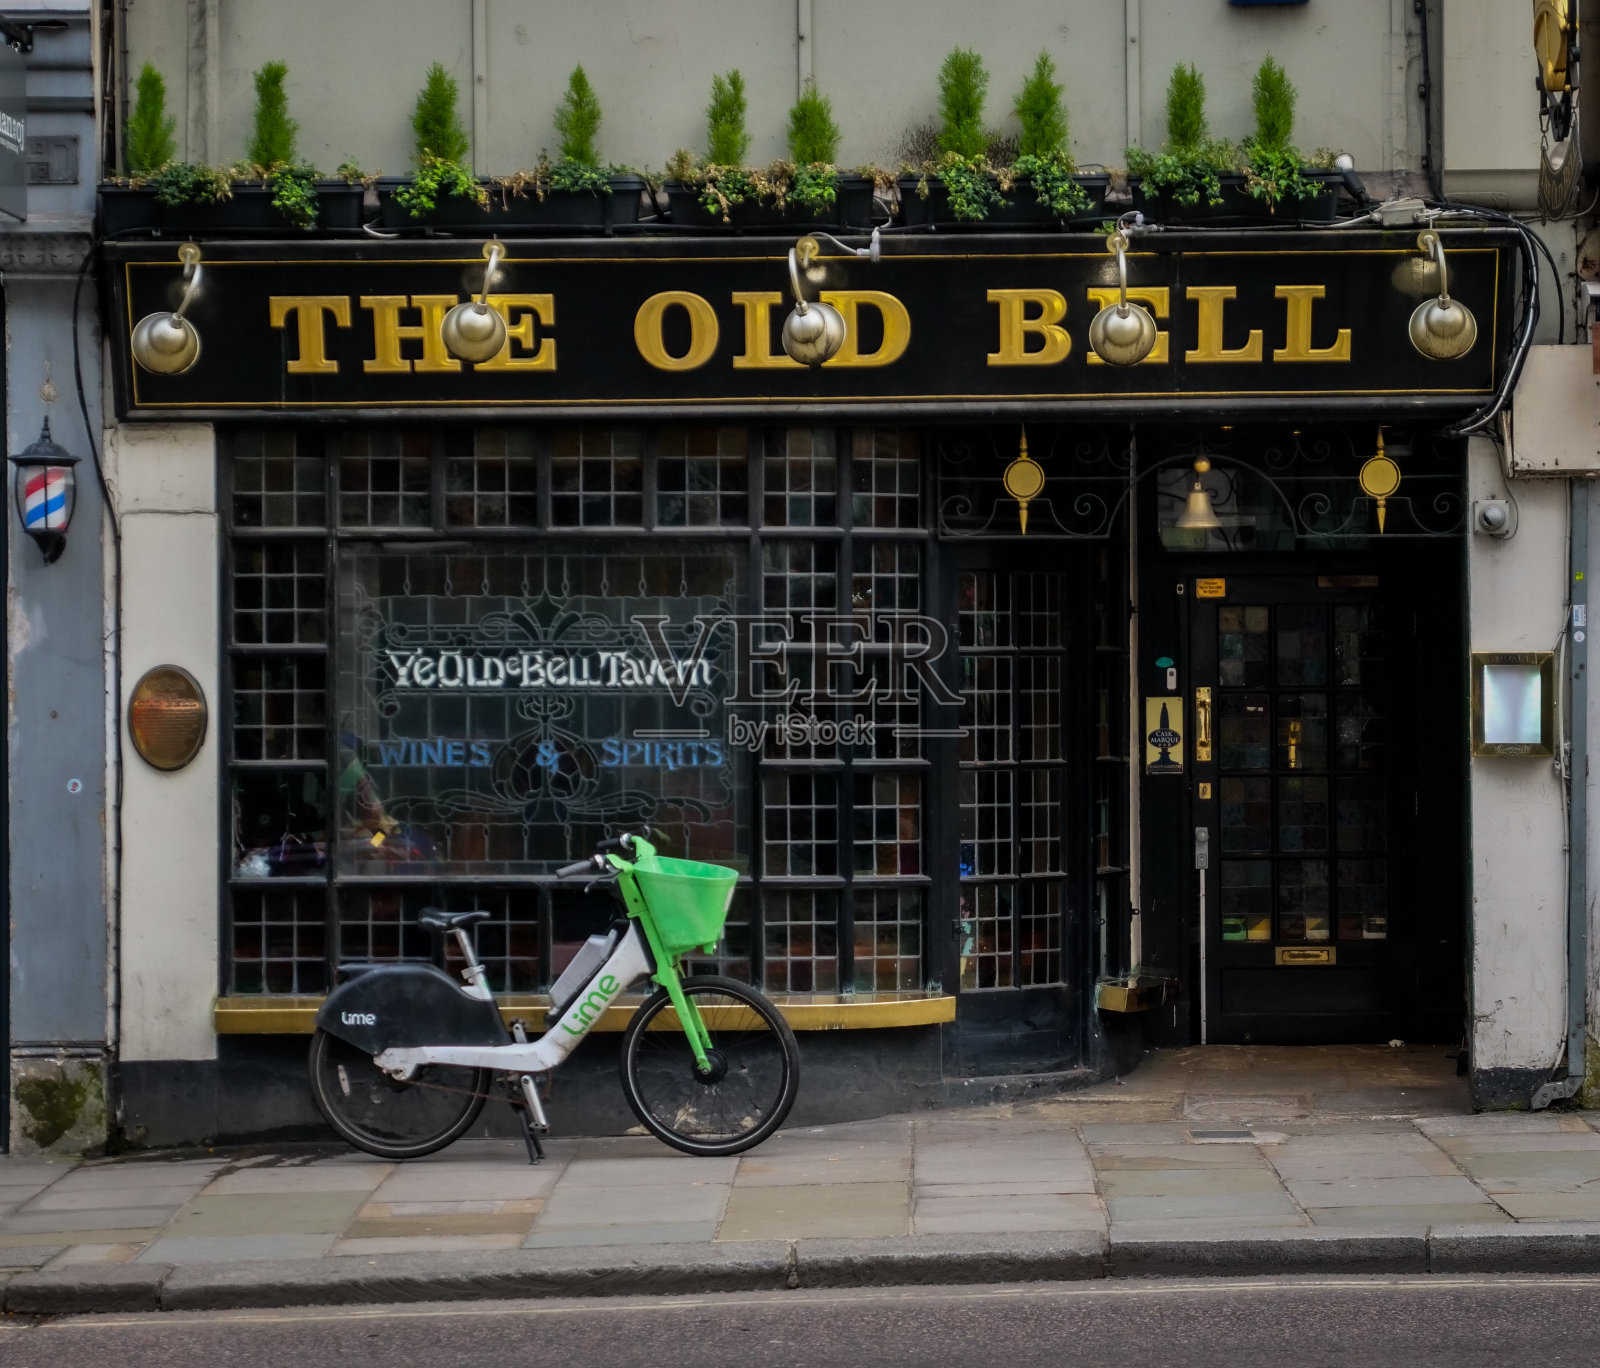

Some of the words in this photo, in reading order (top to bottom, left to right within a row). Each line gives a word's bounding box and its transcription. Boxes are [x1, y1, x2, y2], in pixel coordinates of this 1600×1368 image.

[269, 294, 557, 374] THE
[633, 290, 911, 371] OLD
[379, 737, 491, 767] WINES
[535, 739, 560, 774] &
[601, 738, 725, 770] SPIRITS
[1150, 736, 1179, 744] MARQUE
[340, 1010, 376, 1026] Lime
[560, 973, 621, 1037] Lime
